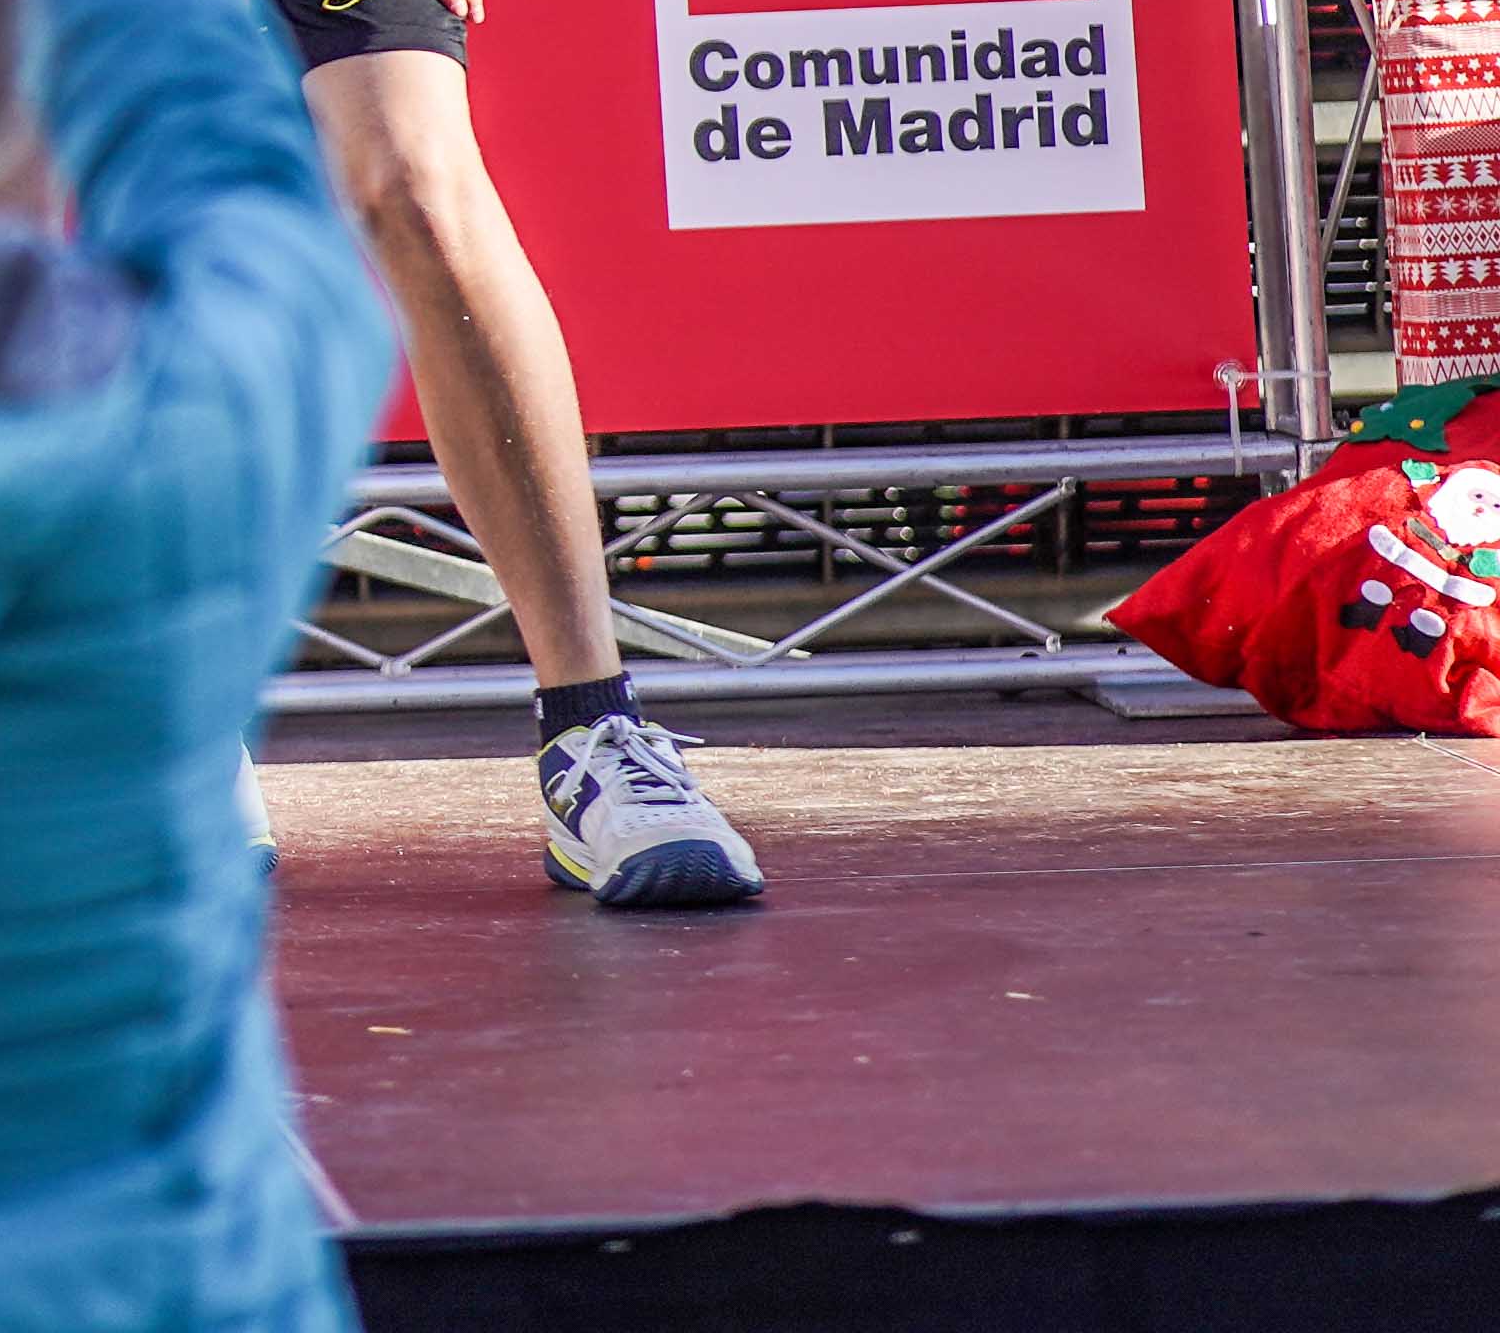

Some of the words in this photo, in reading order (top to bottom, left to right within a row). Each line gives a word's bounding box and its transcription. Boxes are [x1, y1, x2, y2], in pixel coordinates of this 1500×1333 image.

[689, 24, 1107, 92] Comunidad
[693, 103, 792, 162] de
[822, 88, 1109, 156] Madrid
